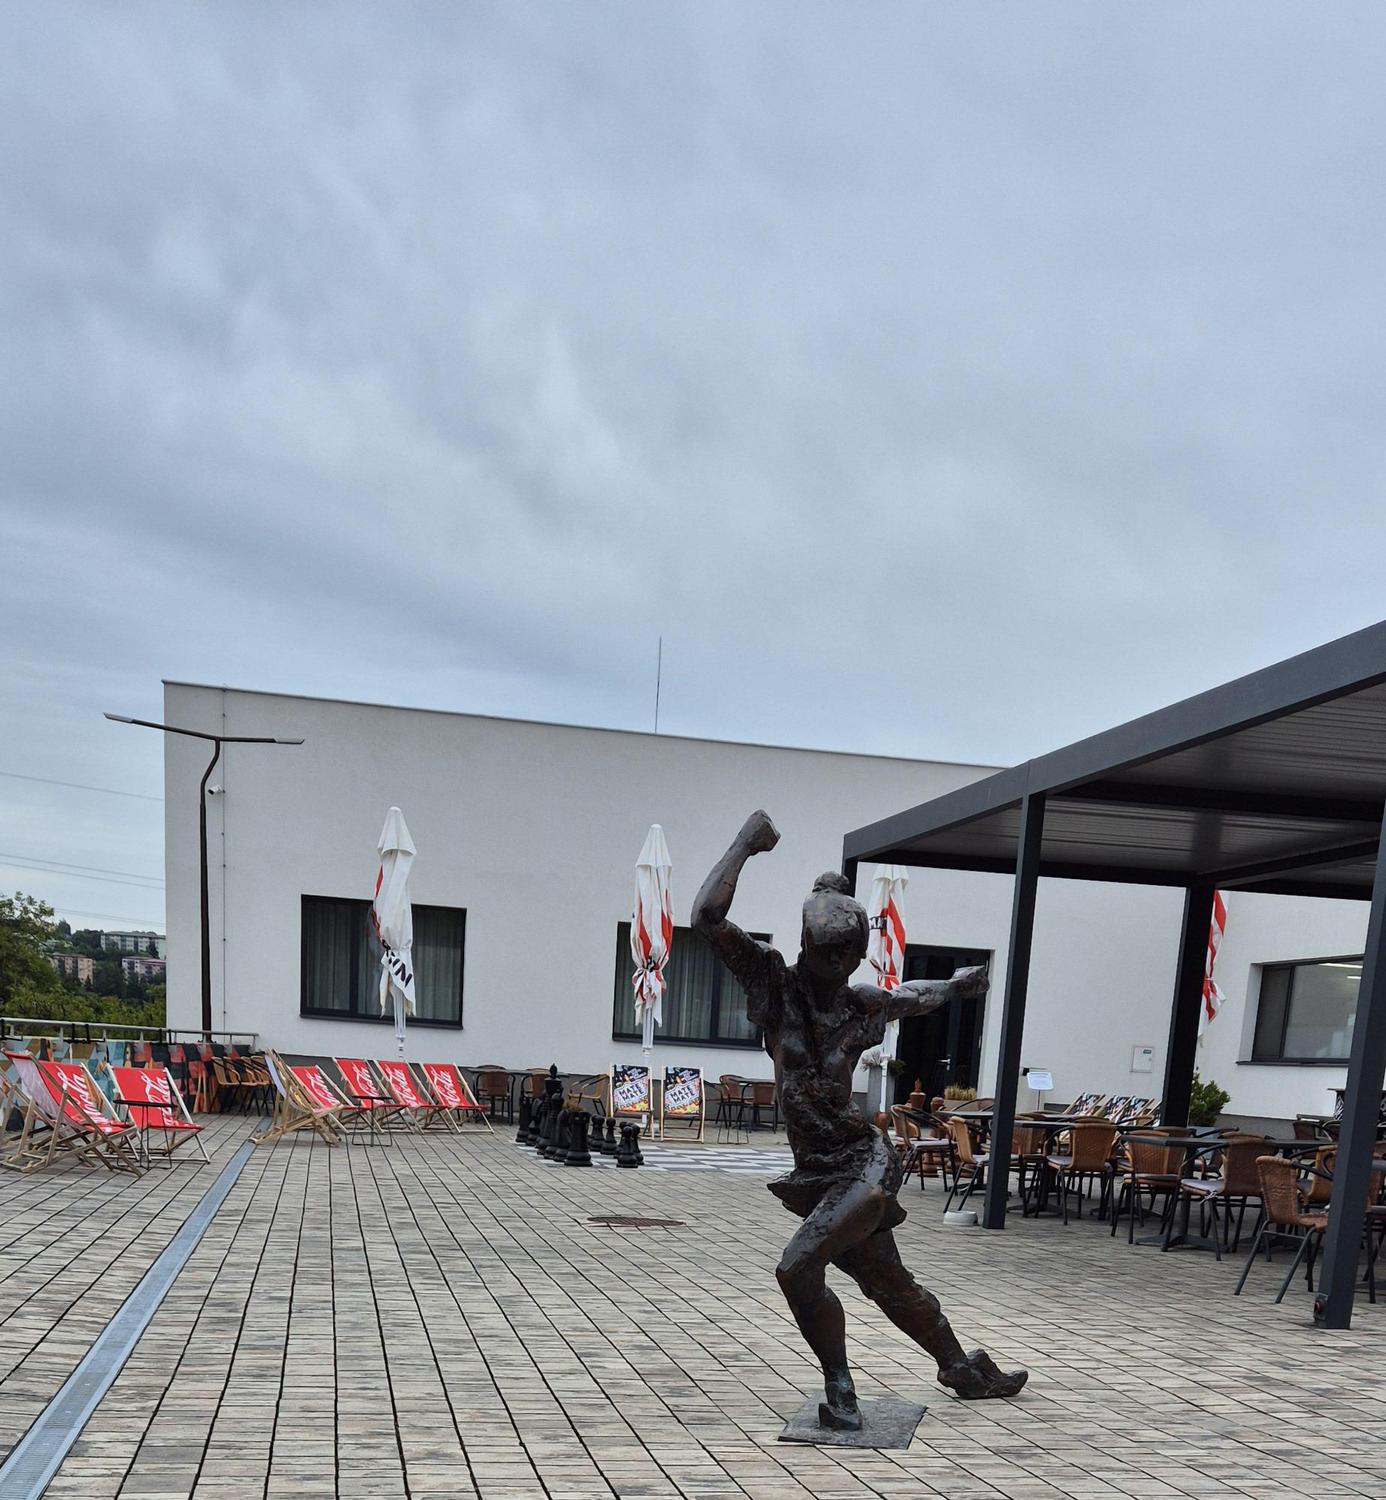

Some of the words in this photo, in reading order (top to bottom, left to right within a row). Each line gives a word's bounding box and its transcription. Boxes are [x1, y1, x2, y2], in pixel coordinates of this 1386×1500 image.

[619, 1083, 641, 1096] MATE
[622, 1089, 644, 1101] MATE
[670, 1085, 692, 1098] MATE
[673, 1091, 695, 1103] MATE
